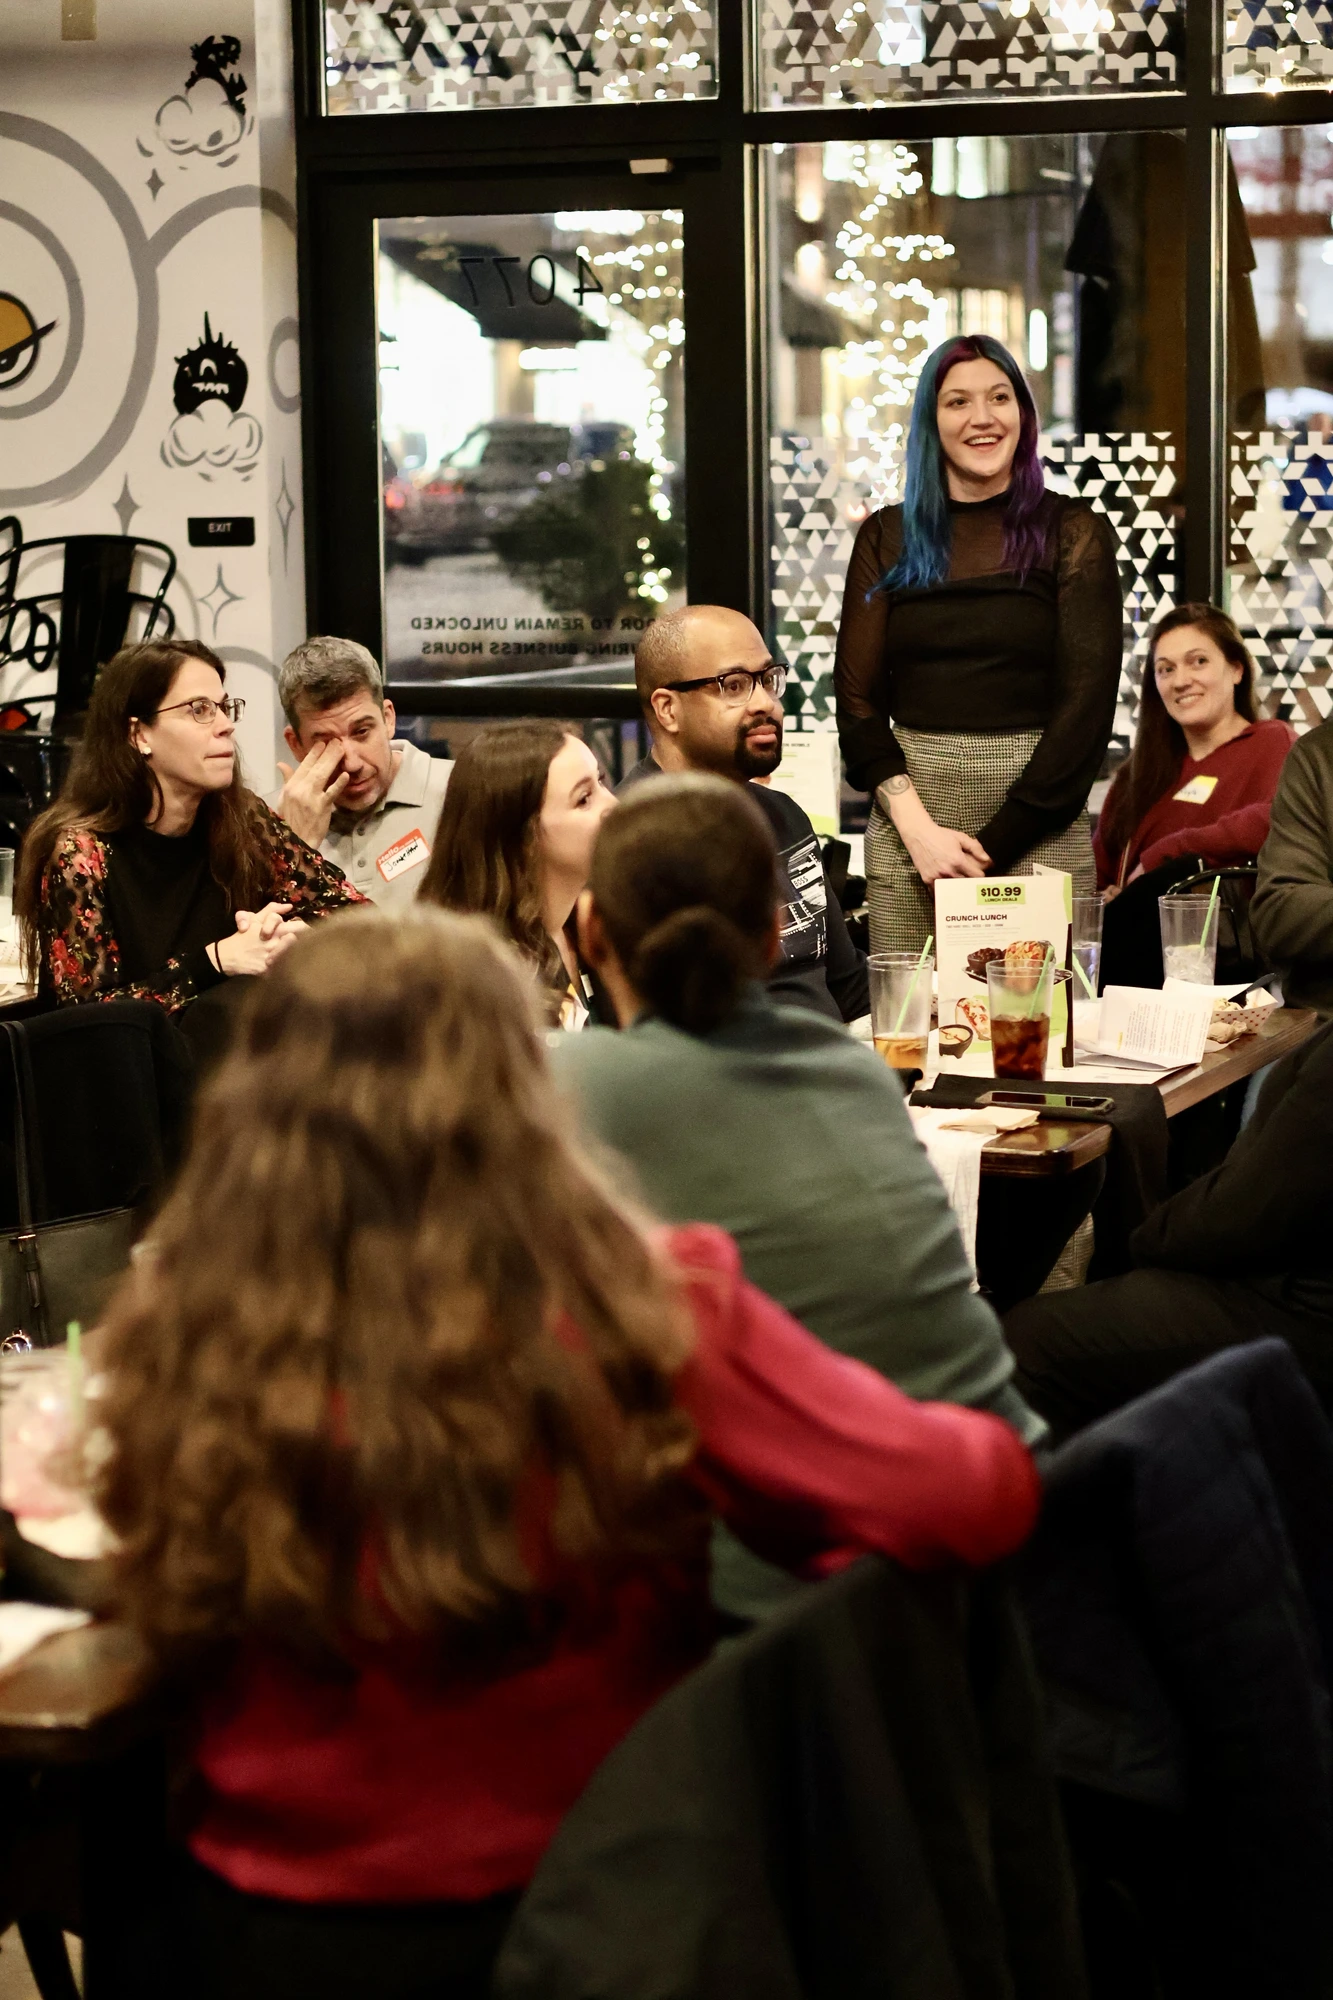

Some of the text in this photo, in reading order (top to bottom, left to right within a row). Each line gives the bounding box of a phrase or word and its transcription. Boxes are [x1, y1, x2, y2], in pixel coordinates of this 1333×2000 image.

[208, 522, 232, 533] EXIT
[981, 886, 1021, 897] $10.99
[945, 914, 979, 922] CRUNCH
